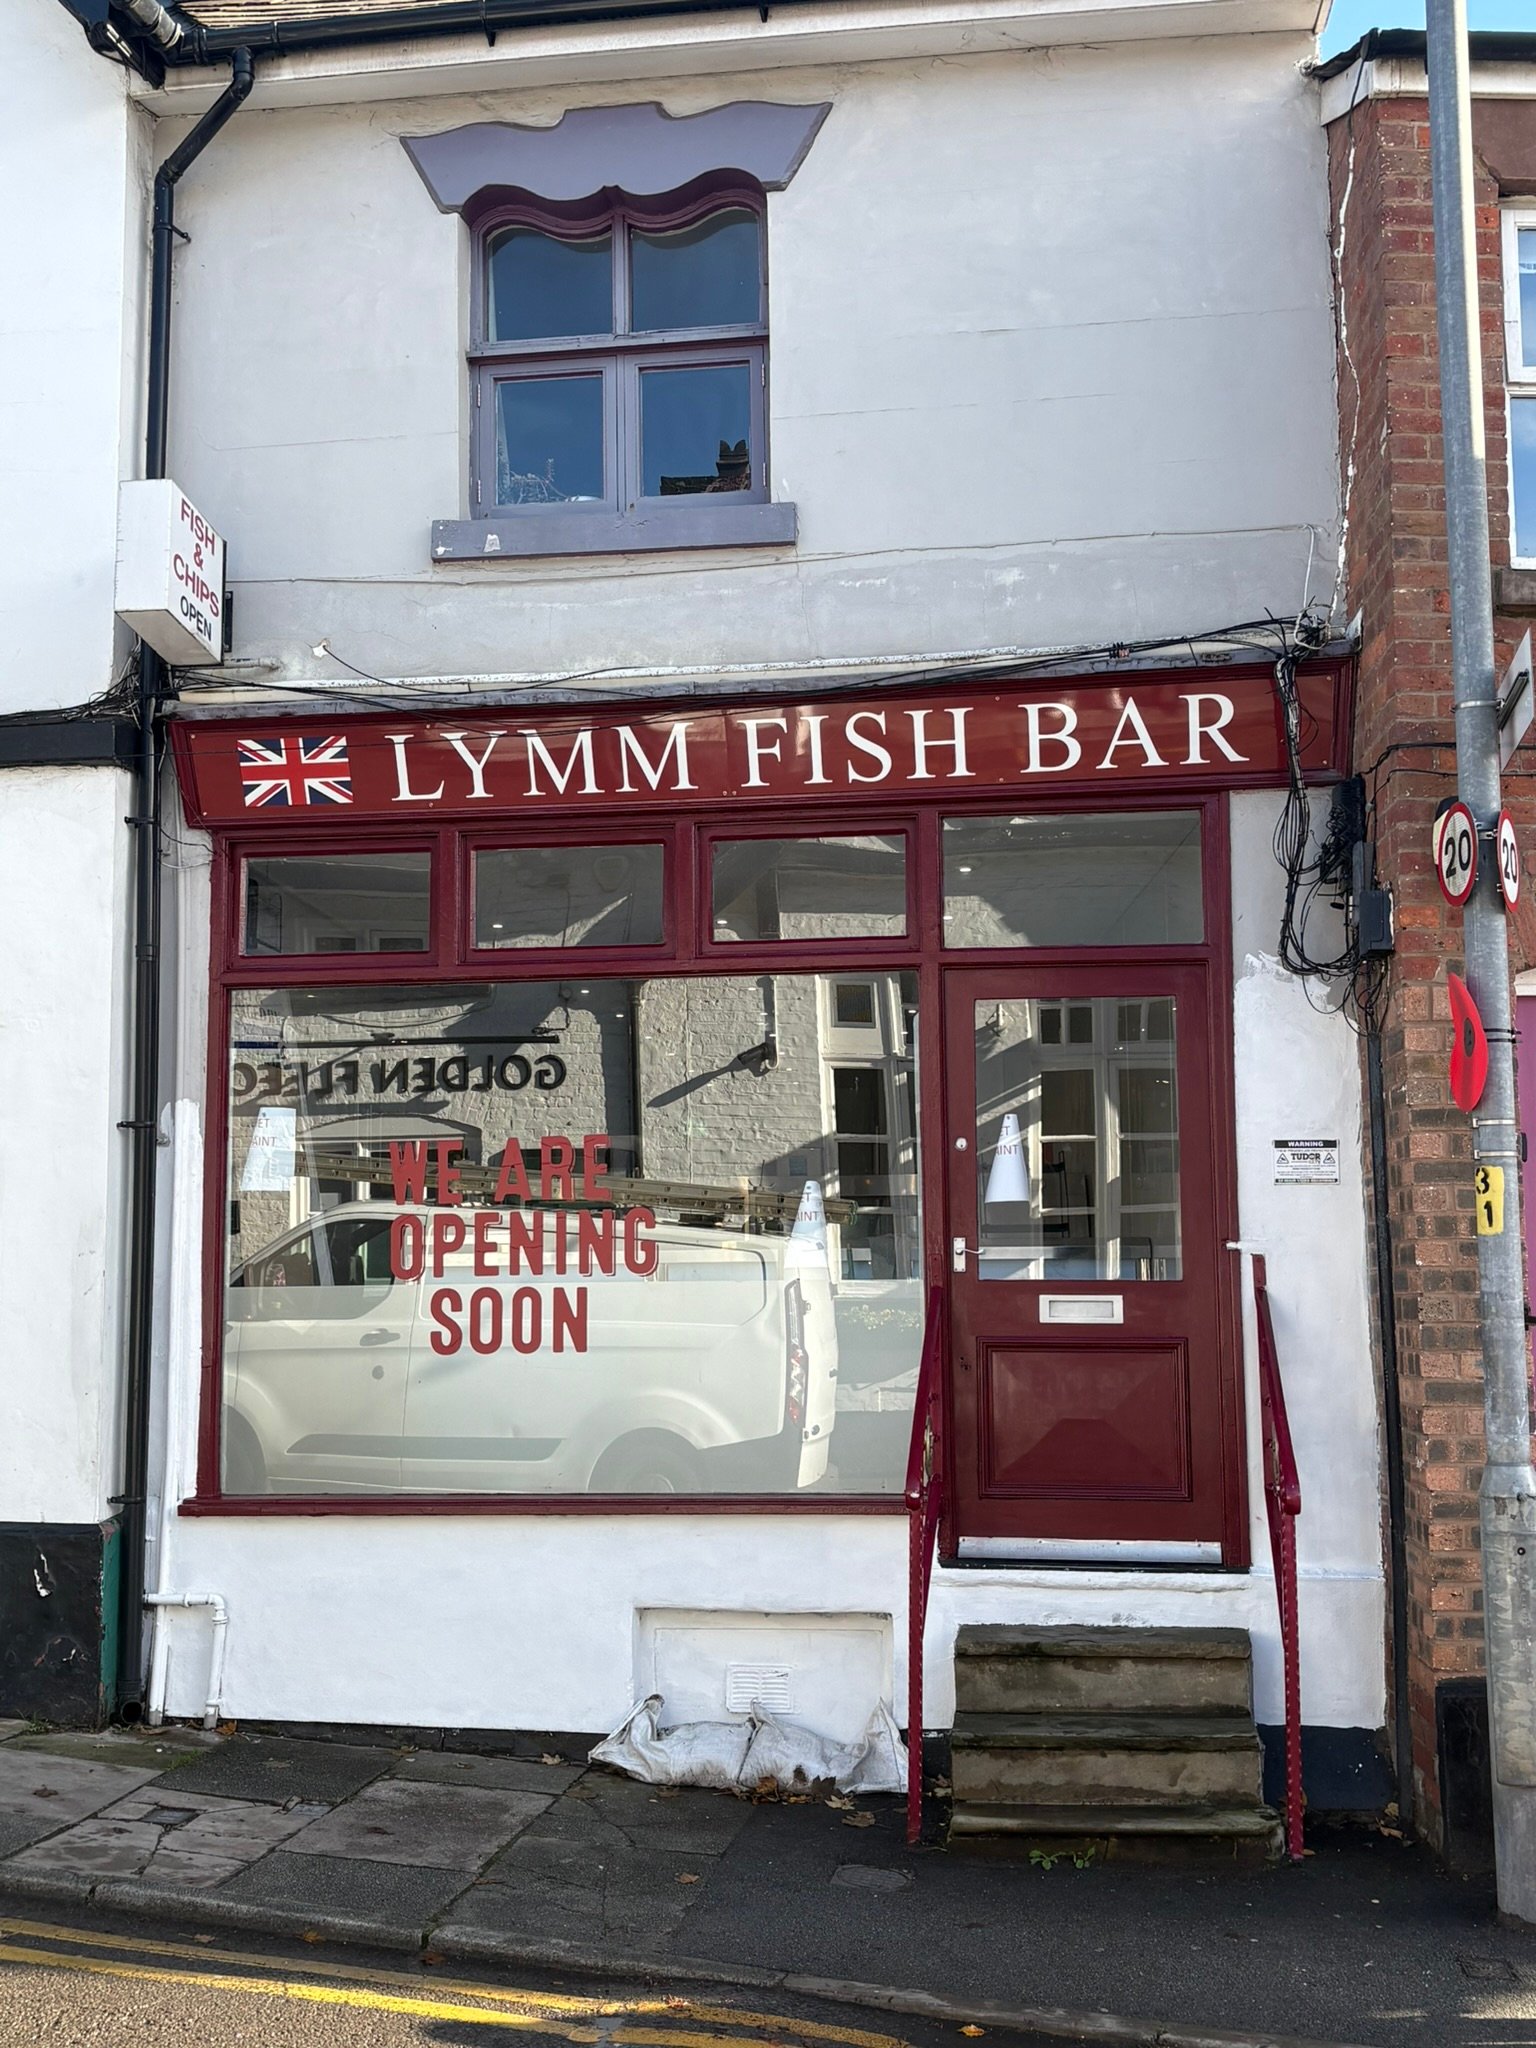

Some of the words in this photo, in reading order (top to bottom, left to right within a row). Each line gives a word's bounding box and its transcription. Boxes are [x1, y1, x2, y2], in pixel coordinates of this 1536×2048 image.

[180, 498, 215, 555] FISH
[193, 543, 204, 571] &
[173, 553, 219, 618] CHIPS
[180, 595, 212, 641] OPEN
[384, 722, 699, 801] LYMM
[736, 707, 976, 788] FISH
[1018, 693, 1250, 774] BAR
[1444, 829, 1470, 879] 20
[1502, 838, 1518, 883] 20
[251, 1136, 277, 1147] AINT
[388, 1140, 464, 1206] WE
[494, 1133, 612, 1203] ARE
[1475, 1167, 1490, 1195] 3
[1484, 1200, 1493, 1228] 1
[390, 1207, 658, 1281] OPENING
[430, 1286, 588, 1355] SOON
